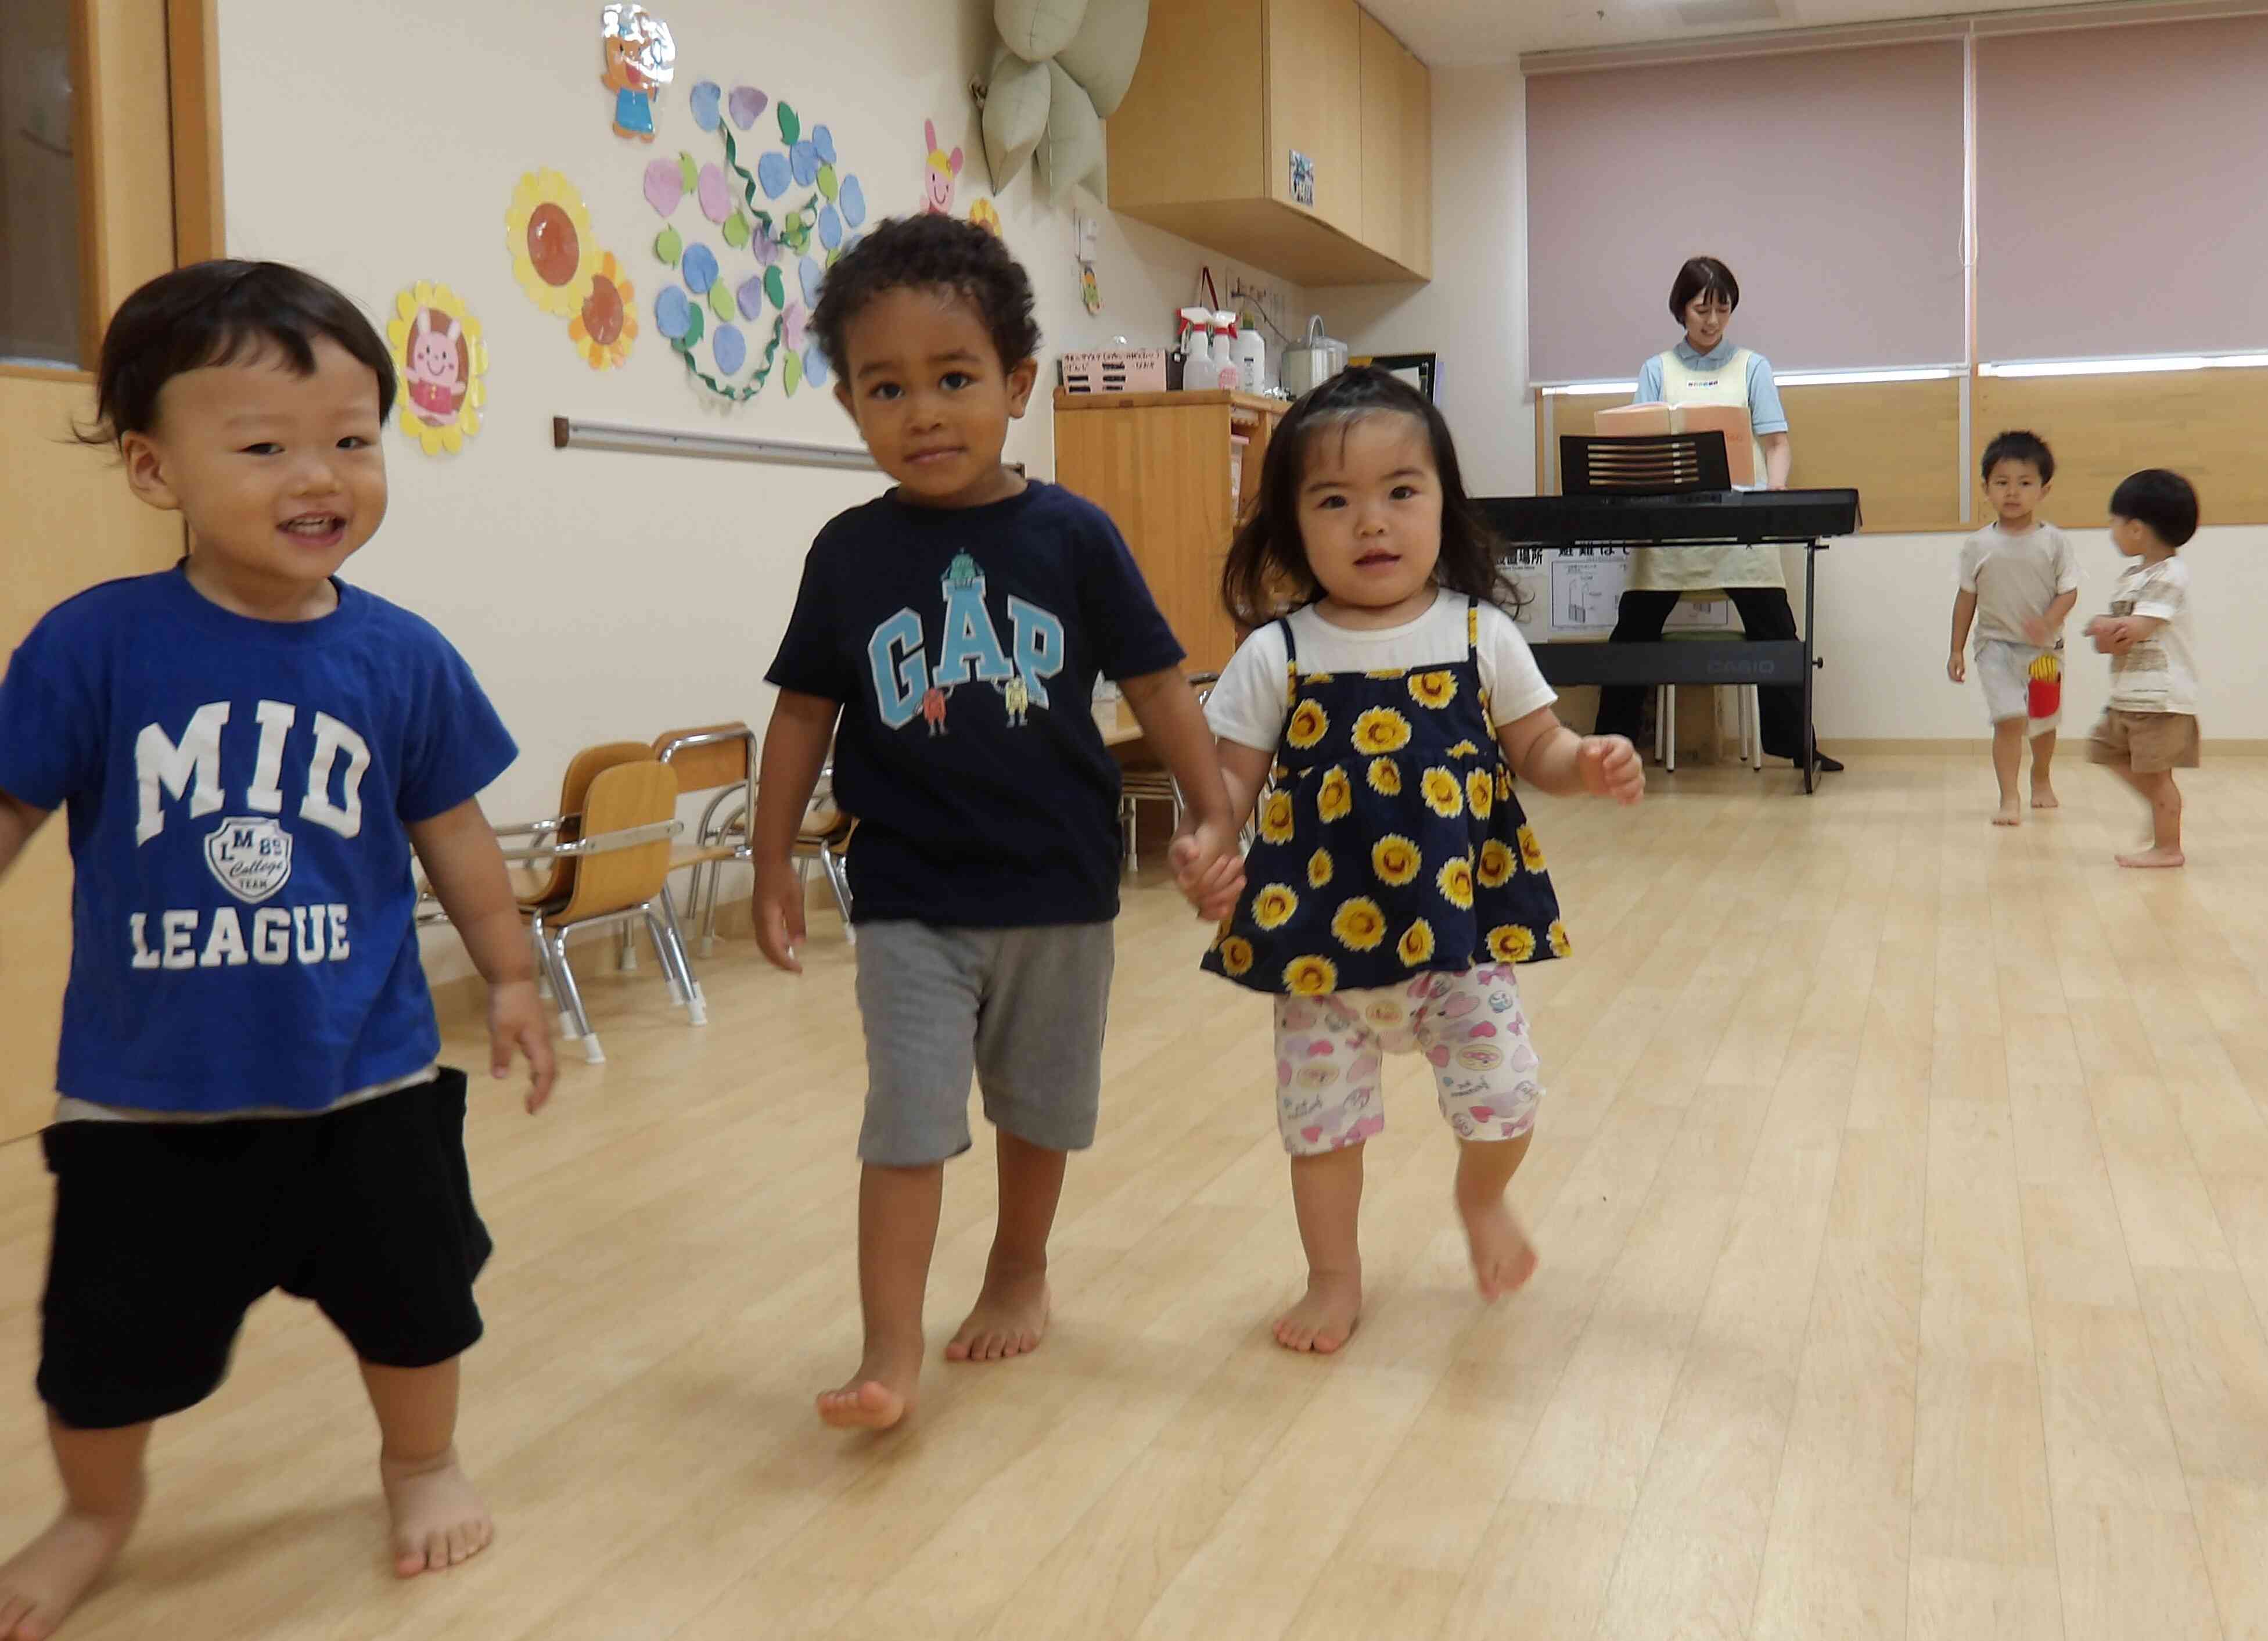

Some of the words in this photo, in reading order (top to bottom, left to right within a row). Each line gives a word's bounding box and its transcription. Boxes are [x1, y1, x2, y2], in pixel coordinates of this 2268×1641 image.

[868, 575, 1064, 730] GAP
[135, 699, 371, 848] MID
[130, 903, 350, 969] LEAGUE
